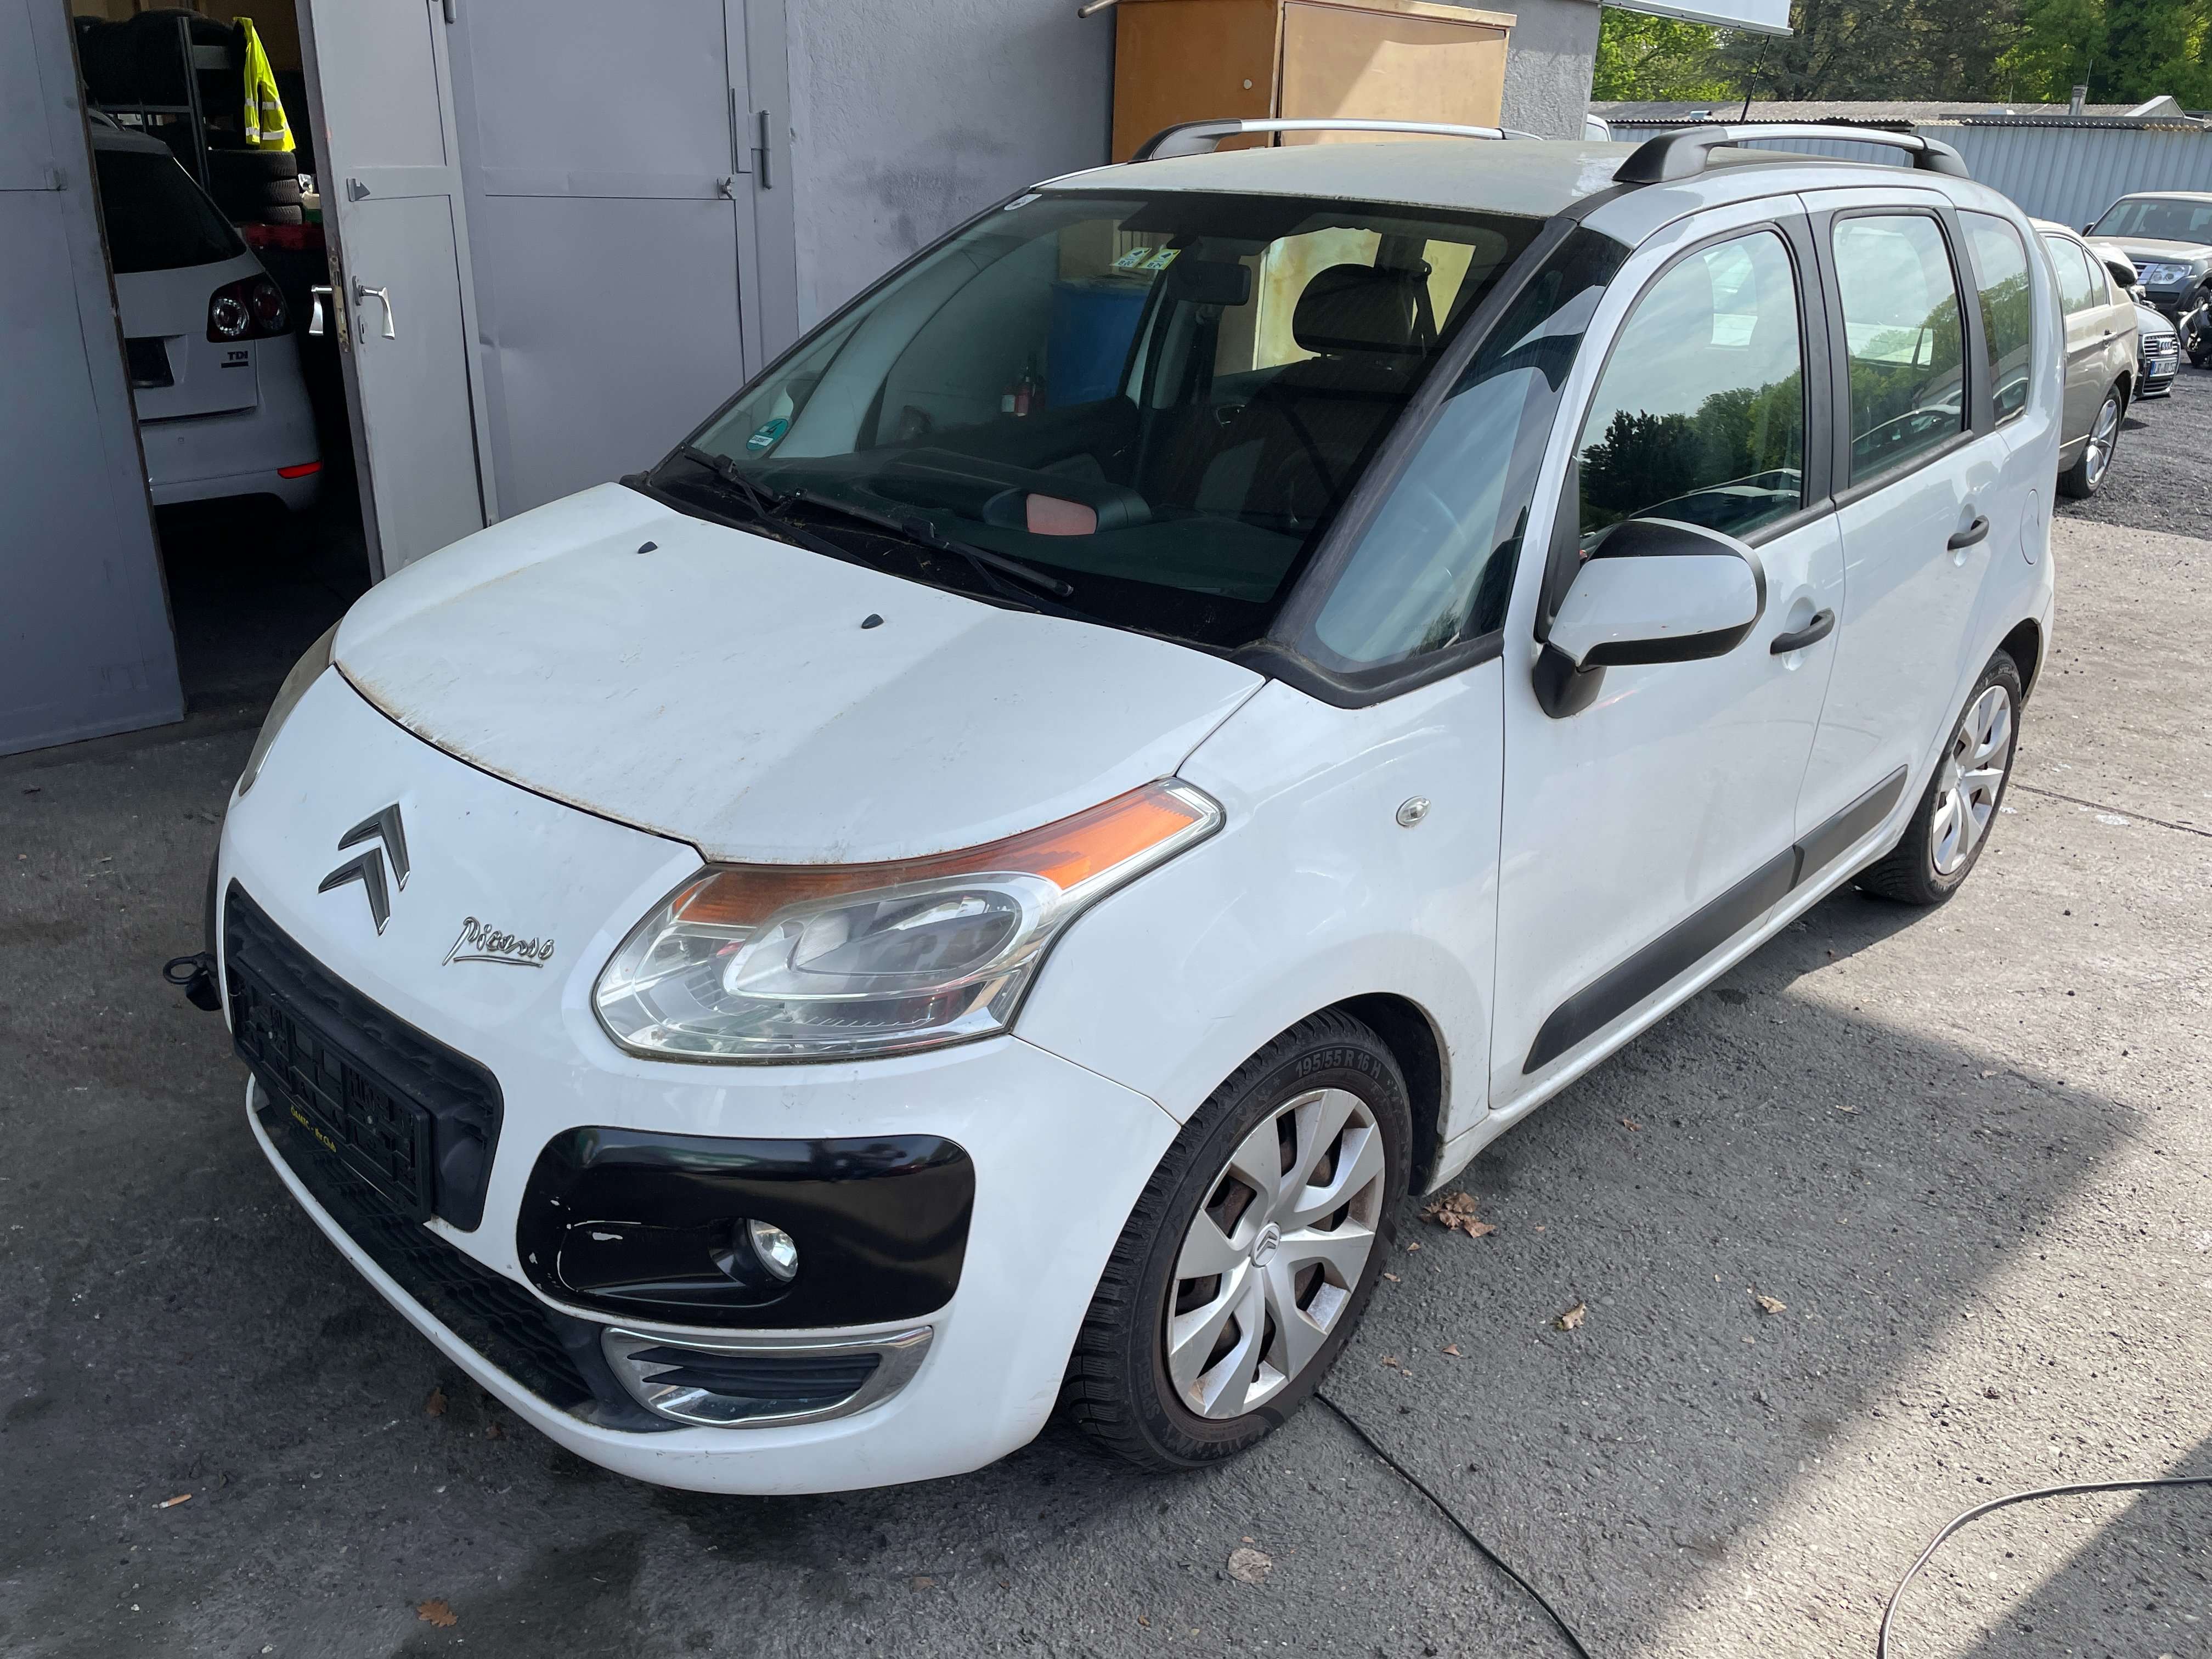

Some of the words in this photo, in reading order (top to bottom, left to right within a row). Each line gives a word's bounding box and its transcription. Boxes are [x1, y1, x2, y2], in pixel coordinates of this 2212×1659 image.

[227, 351, 248, 360] TDI
[765, 420, 782, 436] 4
[442, 916, 554, 966] Picasso
[1296, 1050, 1342, 1078] 195/55
[1344, 1050, 1355, 1067] R
[1357, 1053, 1370, 1071] 16
[1371, 1059, 1382, 1079] H
